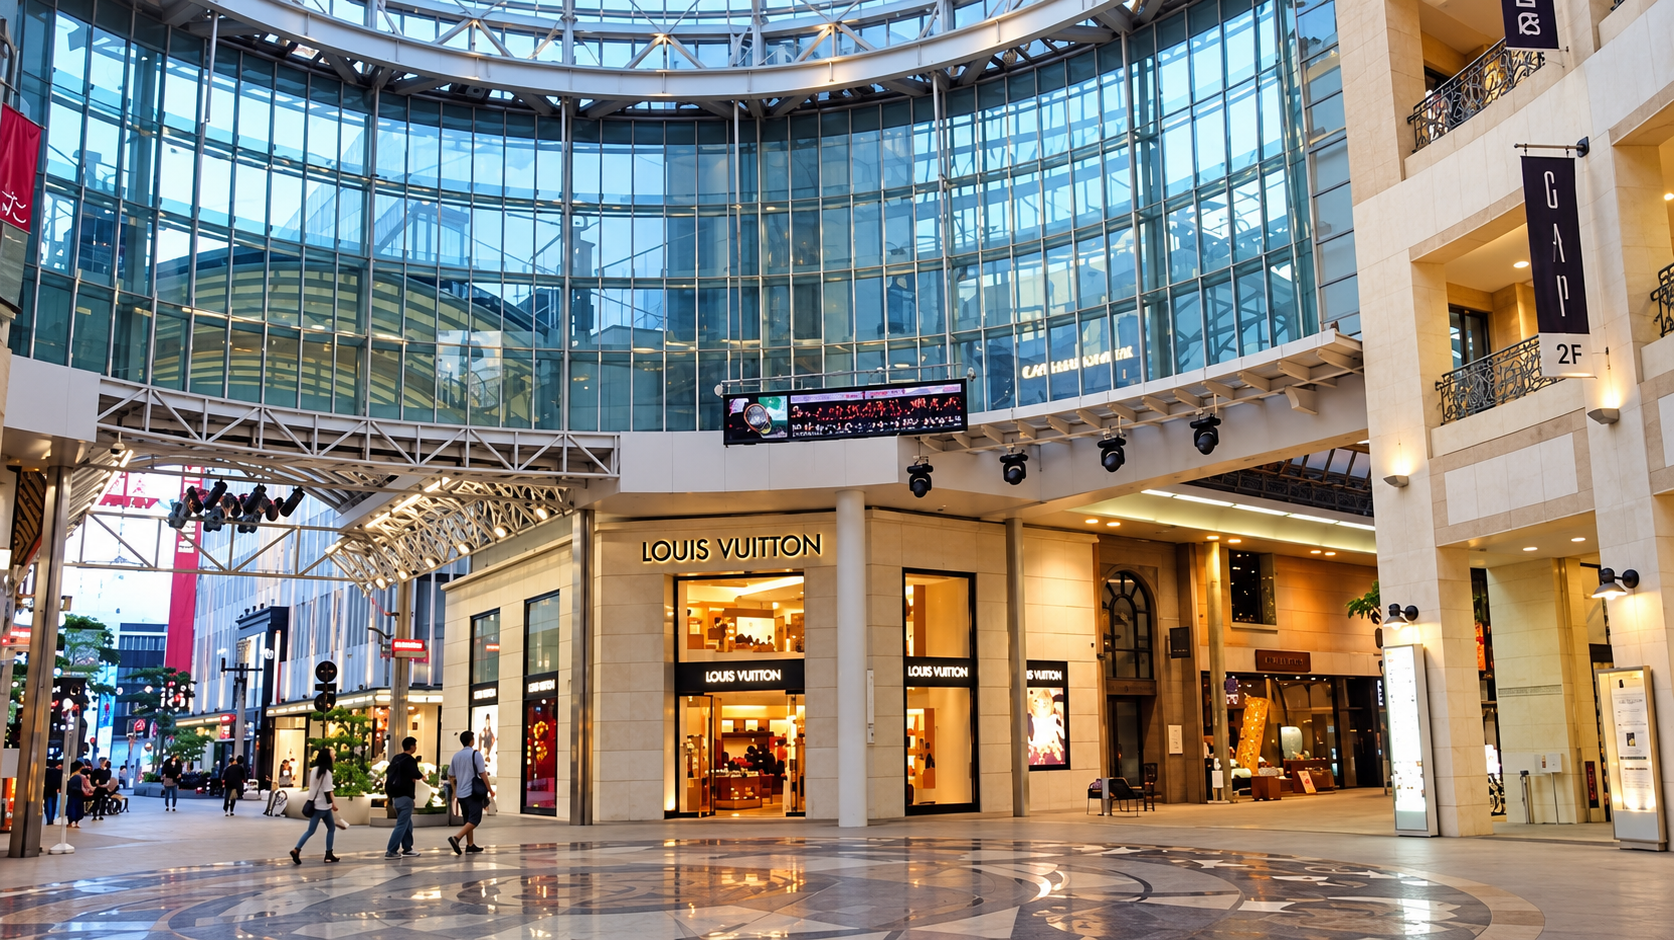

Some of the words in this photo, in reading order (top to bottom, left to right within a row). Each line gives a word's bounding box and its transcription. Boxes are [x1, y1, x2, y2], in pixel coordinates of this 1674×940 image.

[1543, 170, 1569, 317] GAP
[1556, 344, 1582, 365] 2F
[642, 539, 709, 562] LOUIS
[717, 534, 821, 560] VUITTON
[705, 670, 735, 683] LOUIS
[736, 669, 782, 682] VUITTON
[907, 665, 933, 678] LOUIS
[933, 666, 969, 678] VUITTON
[1033, 670, 1063, 681] VUITTON
